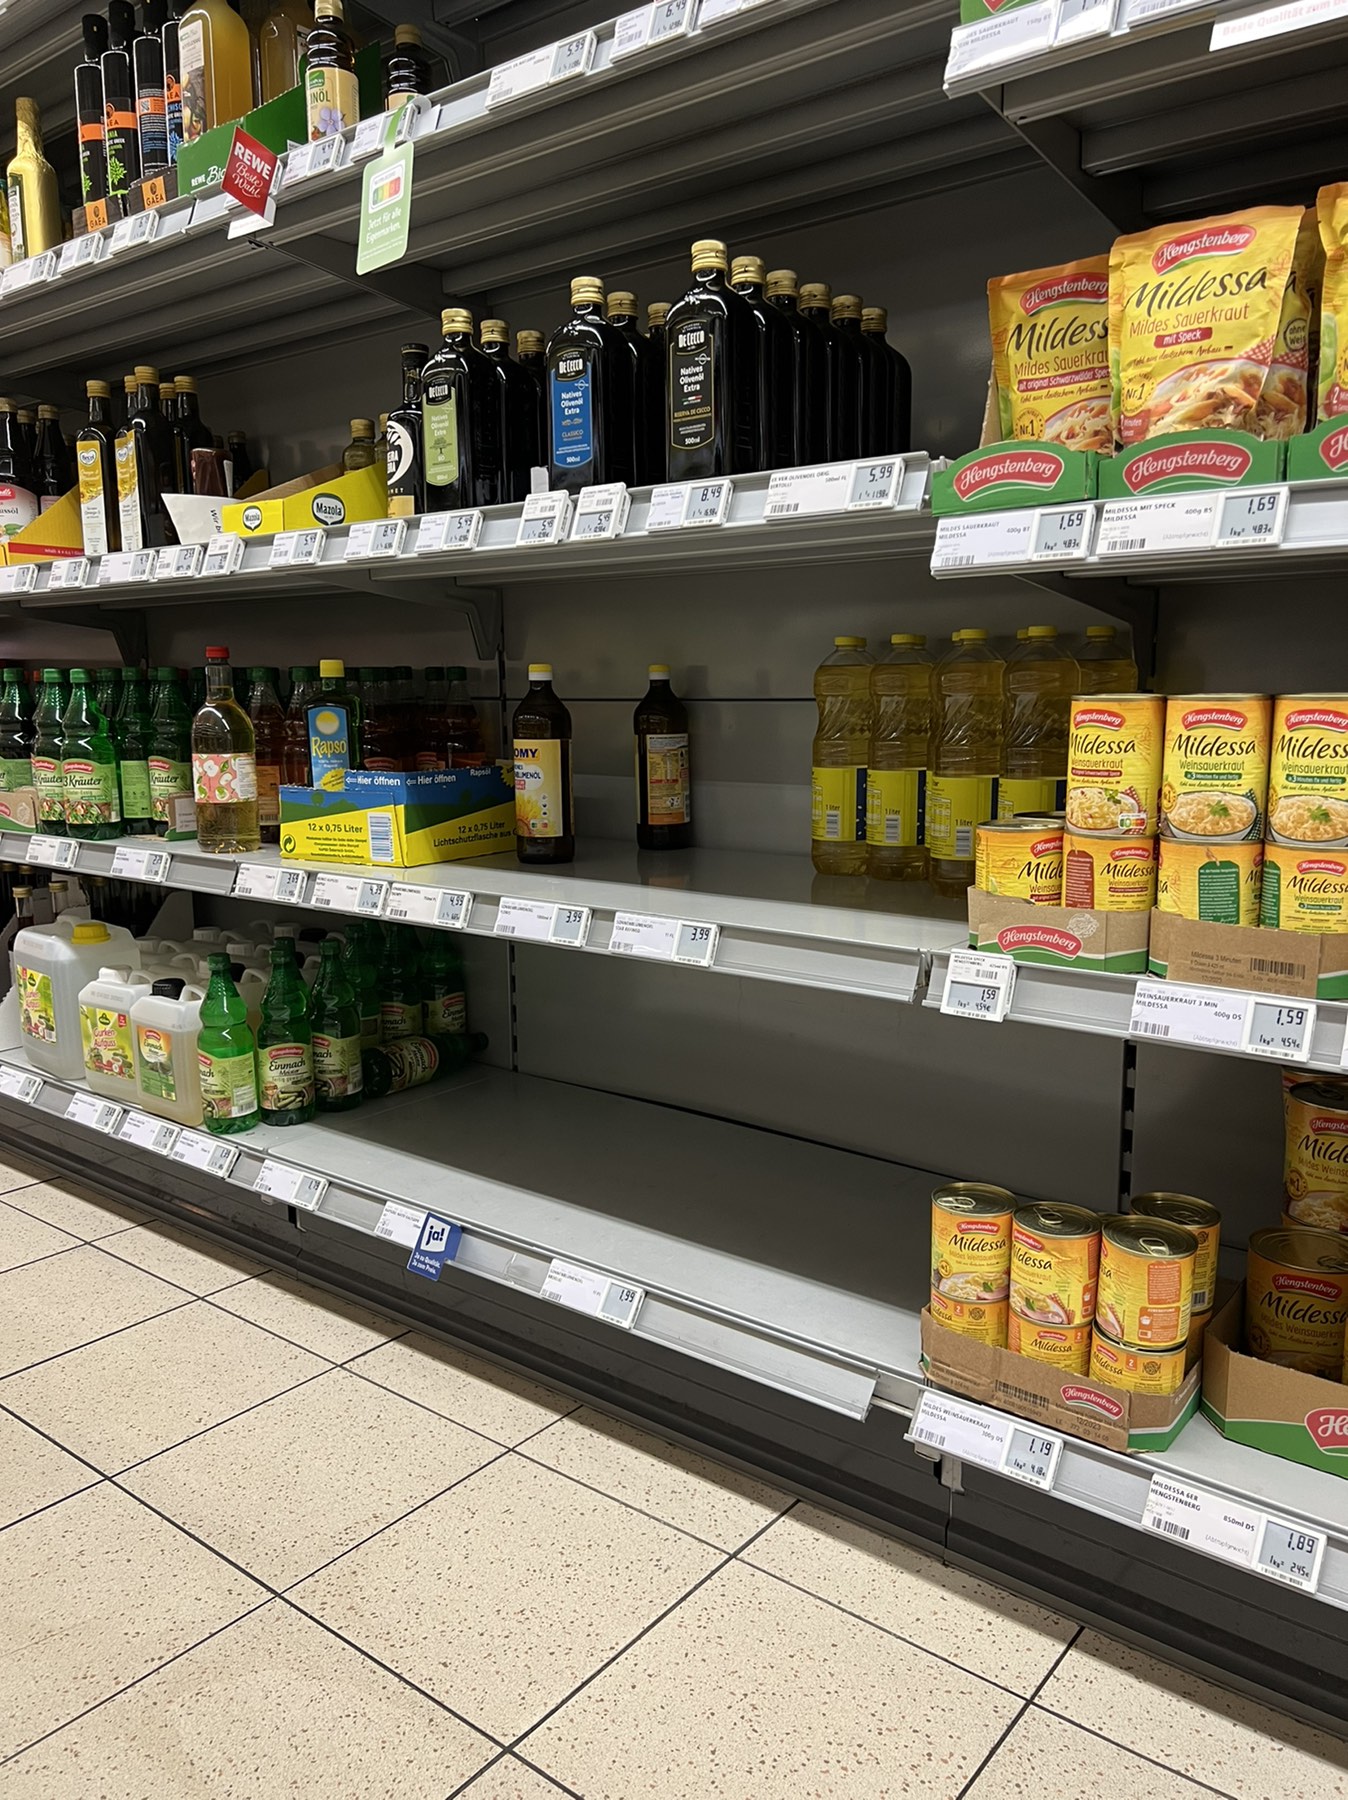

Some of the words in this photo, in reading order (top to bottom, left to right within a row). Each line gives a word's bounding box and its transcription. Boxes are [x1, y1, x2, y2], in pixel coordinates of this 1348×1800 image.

[665, 0, 686, 18] 6.49
[566, 39, 586, 57] 5.99
[234, 141, 272, 180] REWE
[235, 161, 264, 188] Beste
[232, 173, 261, 198] Wahl
[146, 195, 164, 206] GAEA
[89, 217, 106, 228] GAEA
[1158, 232, 1250, 267] Hengstenberg
[1122, 266, 1268, 318] Mildessa
[1129, 318, 1169, 339] Mildes
[1173, 304, 1250, 328] Sauerkraut
[1006, 316, 1109, 361] Mildess
[1163, 334, 1176, 345] mit
[1178, 330, 1202, 343] Speck
[680, 365, 704, 376] Natives
[1014, 358, 1050, 377] Mildes
[679, 373, 704, 385] Olivenöl
[561, 390, 583, 400] Natives
[683, 384, 701, 393] Extra
[1125, 384, 1145, 401] Nr.1
[560, 398, 584, 409] Olivenöl
[564, 407, 580, 416] Extra
[684, 436, 701, 445] 500ml
[566, 456, 581, 464] 500ml
[1132, 450, 1244, 483] Hengstenberg
[869, 465, 893, 483] 5.99
[960, 457, 1057, 491] Hengstenberg
[701, 487, 722, 502] 8.49
[316, 502, 343, 517] Mazola
[1105, 504, 1139, 515] MILDESSA
[1140, 503, 1153, 512] MIT
[1154, 502, 1177, 510] SPECK
[1248, 496, 1276, 515] 1.69
[244, 513, 260, 524] Mazola
[1060, 513, 1084, 530] 1.69
[1103, 513, 1137, 522] MILDESSA
[962, 521, 1000, 531] SAUERKRAUT
[938, 532, 967, 540] MILDESSA
[1185, 710, 1244, 728] Hengstenberg
[311, 736, 347, 758] Rapso
[1171, 733, 1256, 759] Mildessa
[1276, 734, 1348, 760] Mildess
[470, 767, 491, 776] Rapsöl
[1178, 759, 1246, 772] Weinsauerkraut
[69, 775, 102, 787] Kräuter
[357, 776, 371, 785] Hier
[373, 775, 401, 786] öffnen
[417, 776, 432, 785] Hier
[433, 774, 456, 785] öffnen
[308, 822, 317, 832] 12
[325, 823, 343, 834] 0,75
[343, 823, 363, 834] Liter
[458, 825, 467, 834] 12
[473, 823, 490, 833] 0,75
[490, 820, 505, 831] Liter
[434, 830, 499, 848] Lichtschutzflasche
[566, 911, 583, 924] 3.99
[691, 928, 710, 941] 3.99
[1002, 931, 1077, 951] Hengstenberg
[981, 989, 997, 1003] 1.59
[1136, 991, 1197, 1007] WEINSAUERKRAUT
[1203, 1001, 1218, 1009] MIN
[1135, 1000, 1168, 1010] MILDESSA
[1213, 1010, 1230, 1020] 400g
[1276, 1009, 1304, 1026] 1.59
[93, 1027, 116, 1039] Gurken
[93, 1037, 117, 1050] Aufguss
[269, 1057, 306, 1071] Einmach
[425, 1225, 446, 1246] ja!
[948, 1234, 1007, 1253] Mildessa
[1275, 1275, 1339, 1296] Hengstenberg
[619, 1289, 636, 1303] 1.99
[1030, 1338, 1073, 1353] Mildessa
[1128, 1358, 1134, 1368] 2
[1065, 1386, 1120, 1414] Hengstenberg
[921, 1408, 947, 1422] MILDESSA
[923, 1401, 942, 1412] MILDES
[942, 1407, 991, 1430] WEINSAUERKRAUT
[1029, 1438, 1052, 1456] 1.19
[1152, 1479, 1185, 1497] MILDESSA
[1186, 1491, 1199, 1502] 6ER
[1150, 1487, 1201, 1512] HENGSTENBERG
[1223, 1515, 1245, 1528] 850ml
[1245, 1523, 1255, 1532] DS
[1286, 1532, 1316, 1554] 1.89
